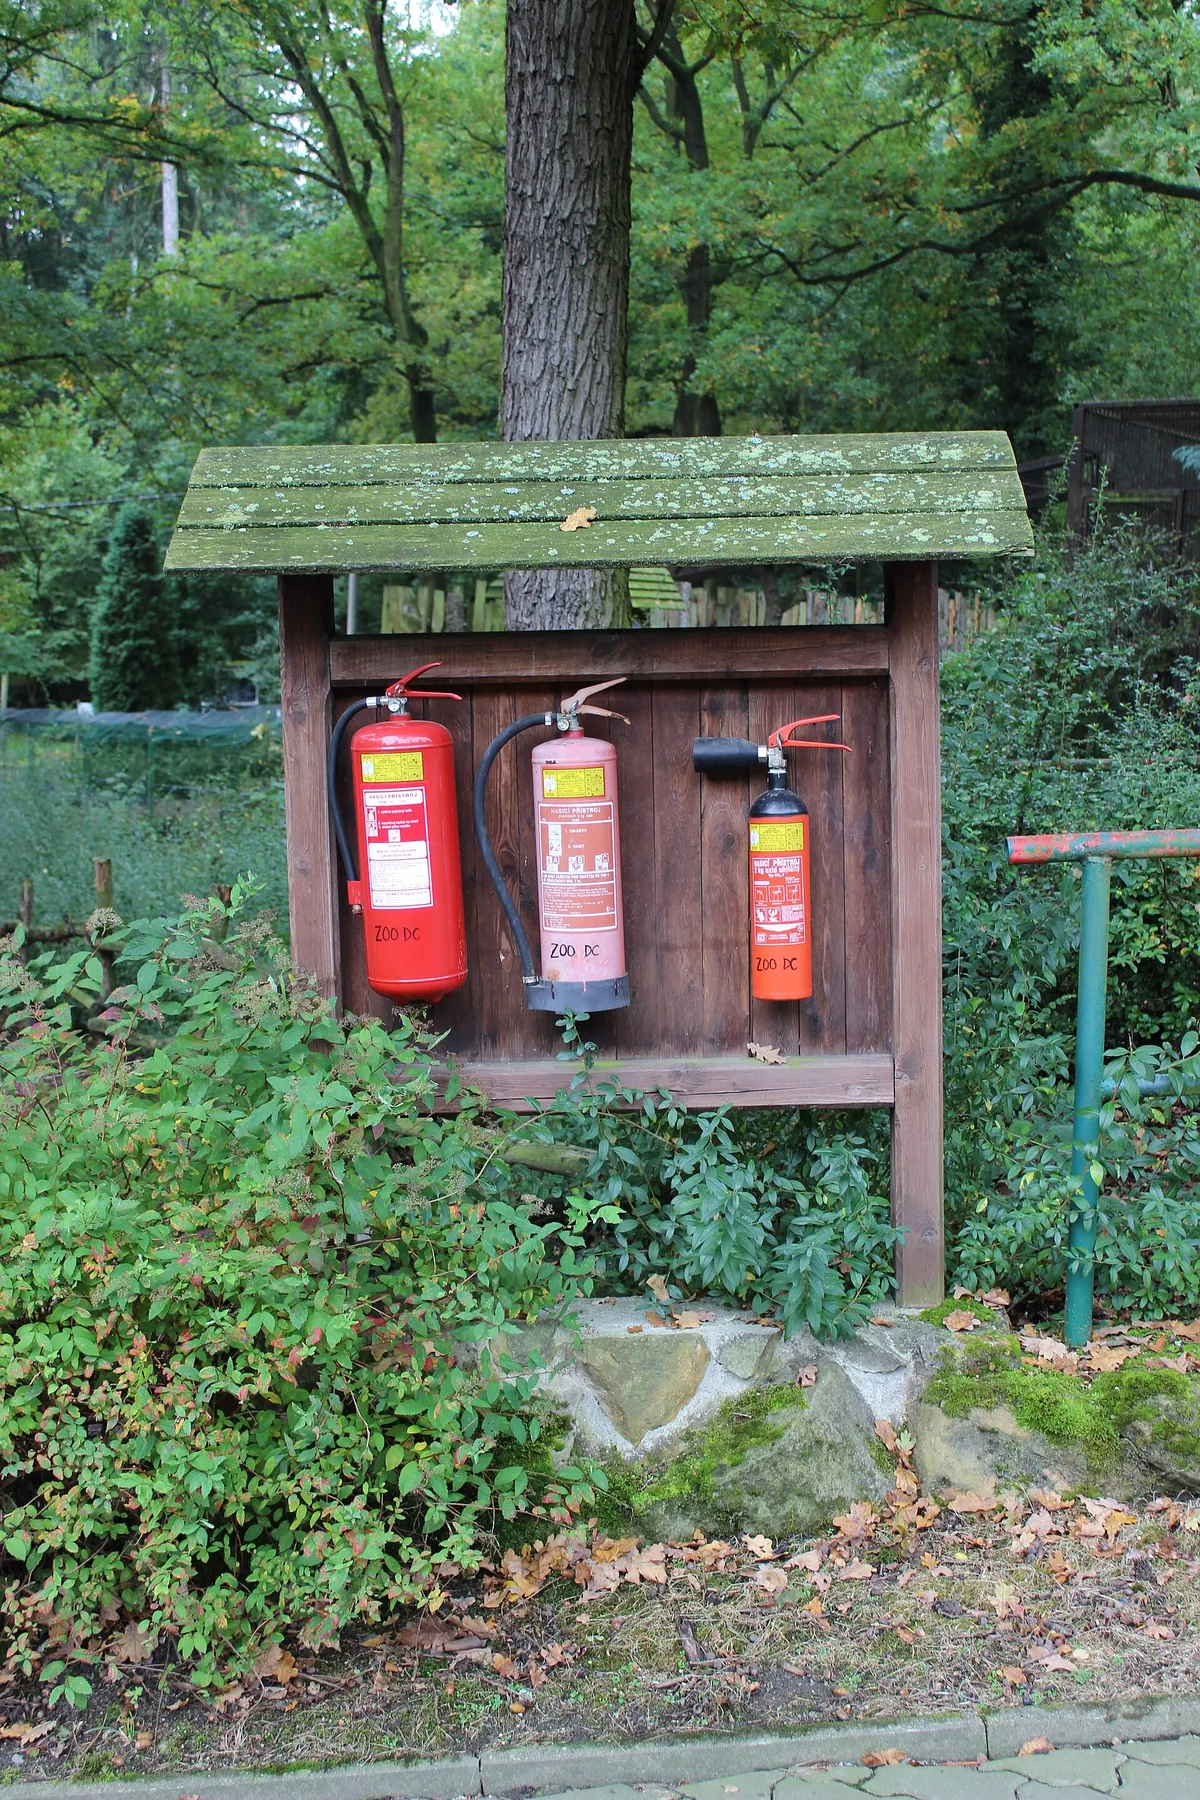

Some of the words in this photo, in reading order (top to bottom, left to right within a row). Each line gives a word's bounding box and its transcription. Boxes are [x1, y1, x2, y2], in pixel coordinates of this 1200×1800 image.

[374, 925, 399, 942] ZOO
[403, 926, 421, 942] DC
[550, 943, 576, 958] ZOO
[584, 944, 600, 957] DC
[756, 957, 777, 971] ZOO
[783, 957, 798, 971] DC
